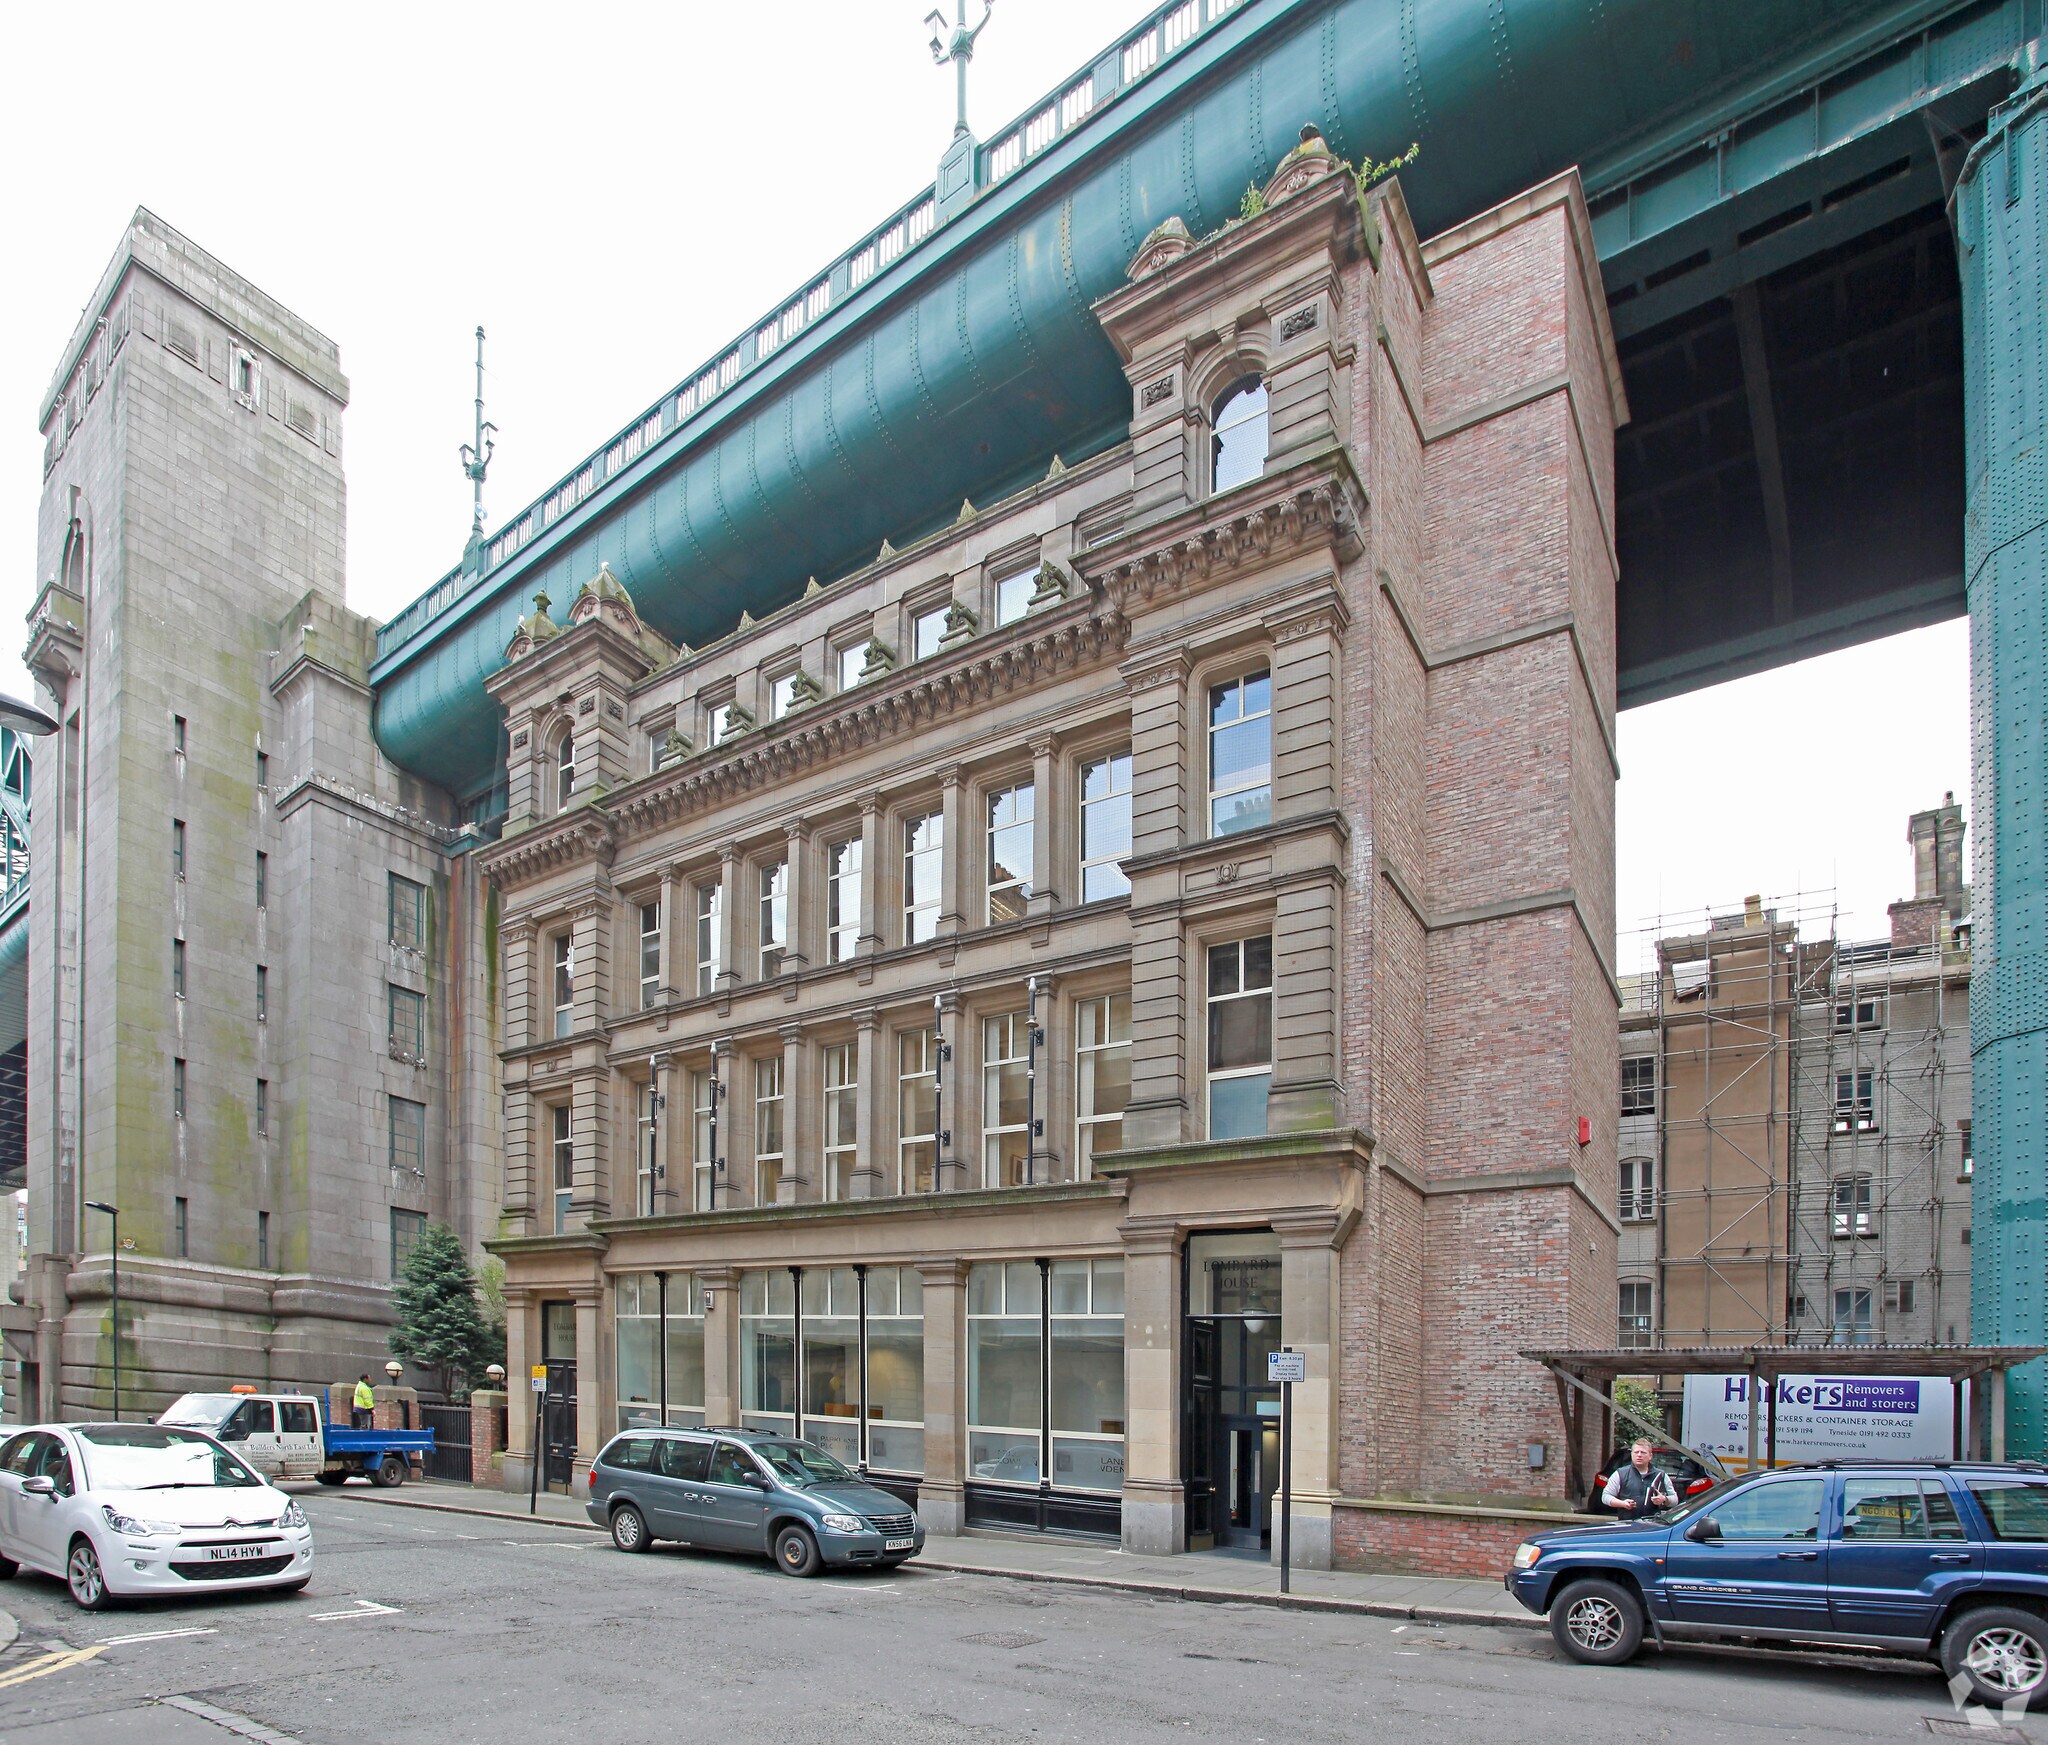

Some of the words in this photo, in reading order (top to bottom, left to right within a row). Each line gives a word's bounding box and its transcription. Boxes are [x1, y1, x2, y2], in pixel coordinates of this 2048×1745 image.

[1203, 1259, 1269, 1272] LOMBARD
[553, 1322, 576, 1331] LOMBAR
[1724, 1377, 1842, 1406] Hkers
[1846, 1383, 1904, 1395] Removers
[1845, 1398, 1867, 1408] and
[1872, 1399, 1916, 1409] storers
[1816, 1416, 1867, 1426] CONTAINER
[1872, 1418, 1914, 1428] STORAGE
[1829, 1429, 1856, 1438] Tyneside
[1776, 1438, 1867, 1448] www.harkersremovers.co.uk
[210, 1548, 237, 1559] NL14
[241, 1546, 262, 1558] HYW
